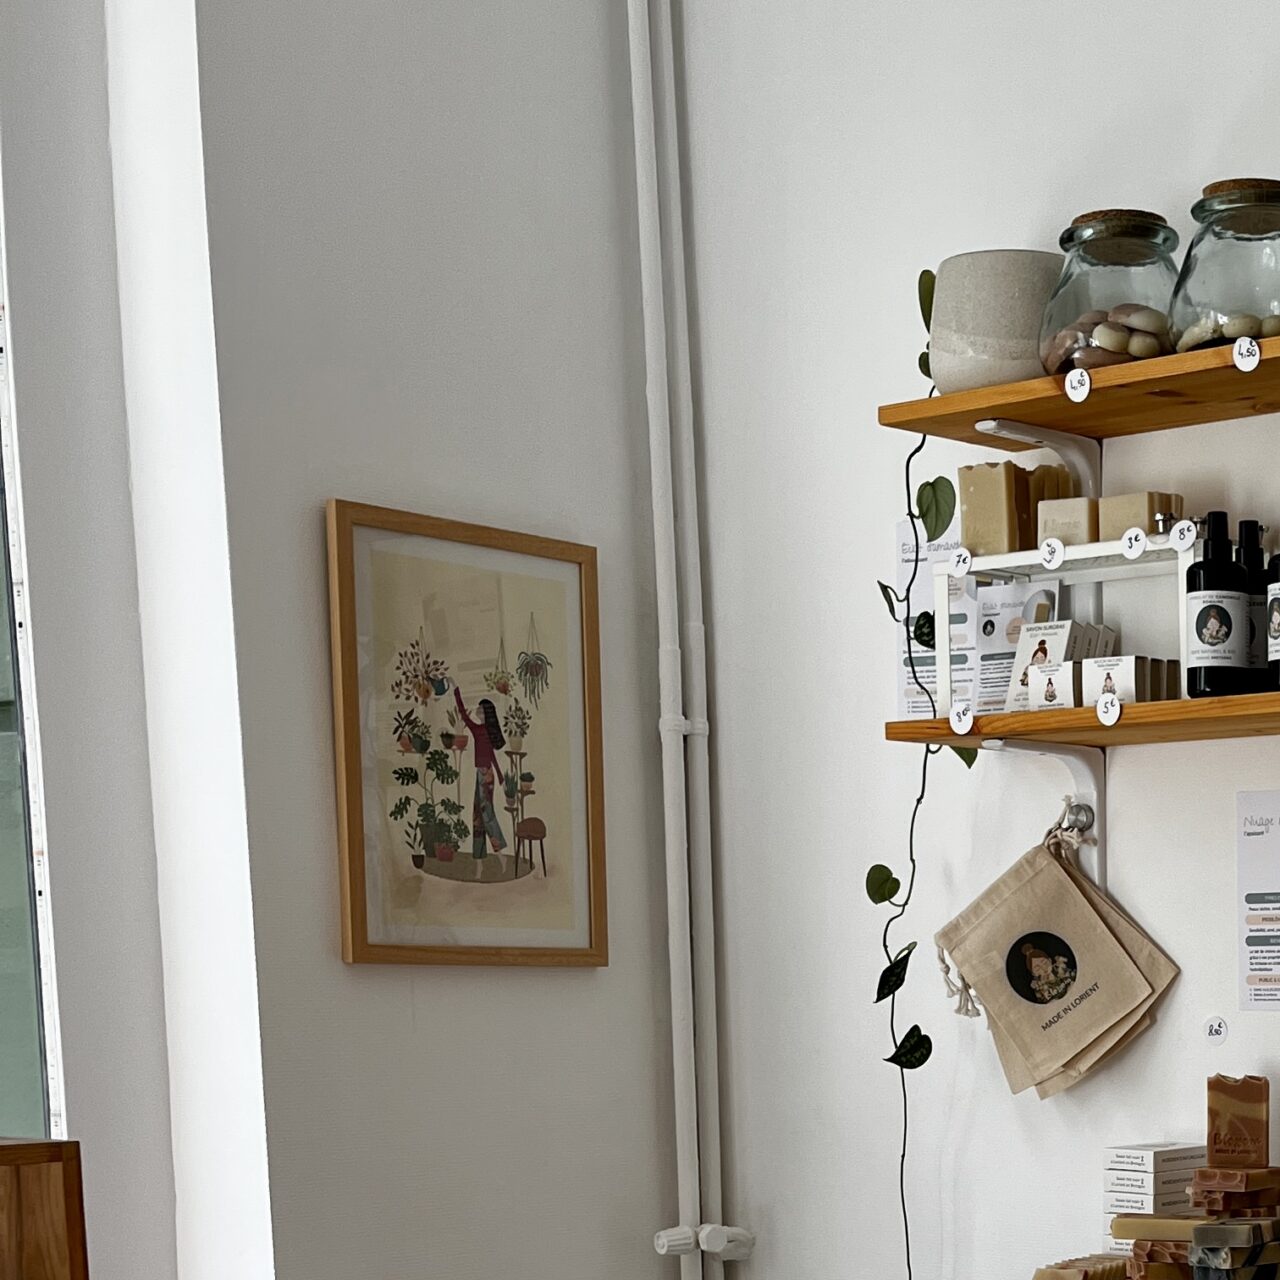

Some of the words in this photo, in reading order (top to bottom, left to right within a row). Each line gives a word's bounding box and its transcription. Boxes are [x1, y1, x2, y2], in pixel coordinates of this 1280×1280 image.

[1179, 525, 1193, 540] 8€
[1128, 533, 1140, 549] 3€
[956, 553, 968, 567] 7€
[1103, 701, 1116, 714] 5€
[1041, 1011, 1064, 1032] MADE
[1063, 1004, 1073, 1017] IN
[1071, 982, 1101, 1008] LORIENT
